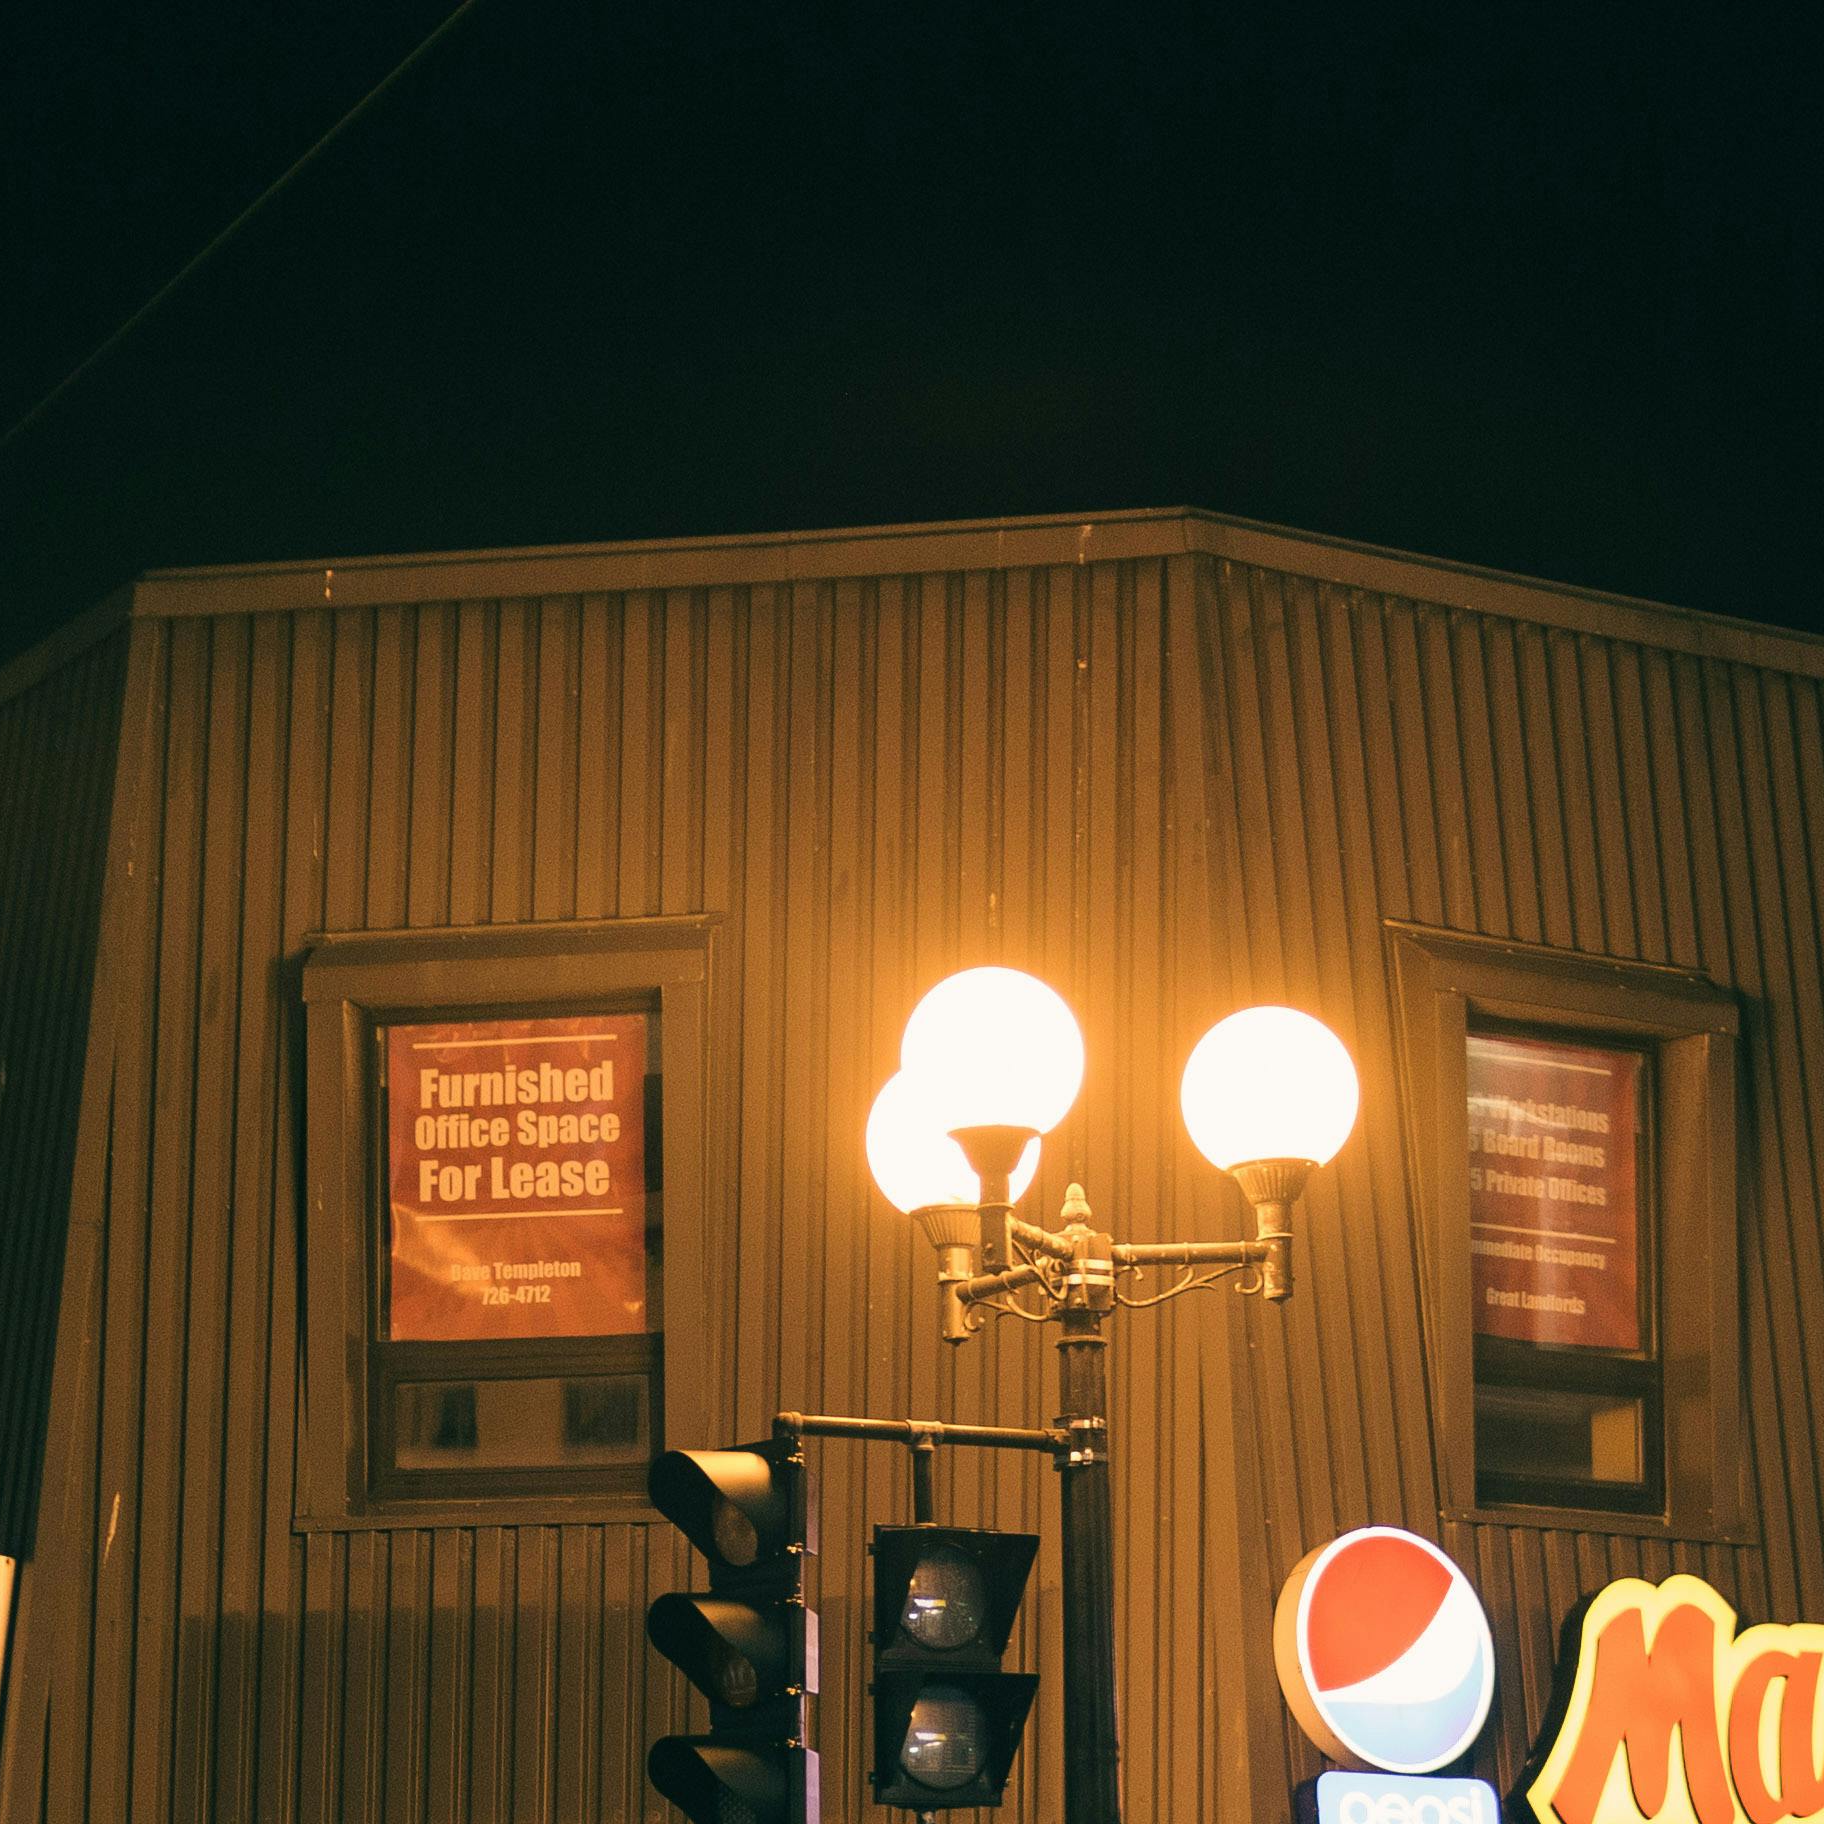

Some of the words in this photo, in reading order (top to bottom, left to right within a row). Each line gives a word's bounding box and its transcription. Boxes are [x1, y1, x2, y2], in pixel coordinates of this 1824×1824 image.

[420, 1060, 614, 1109] Furnished
[415, 1114, 510, 1151] Office
[517, 1110, 621, 1149] Space
[419, 1158, 482, 1202] For
[491, 1155, 611, 1200] Lease
[1485, 1169, 1546, 1199] Private
[1547, 1177, 1607, 1206] Offices
[1471, 1239, 1533, 1262] mmediate
[451, 1263, 491, 1282] Dave
[493, 1260, 581, 1283] Templeton
[481, 1285, 552, 1306] 726-4712
[1486, 1287, 1520, 1307] Great
